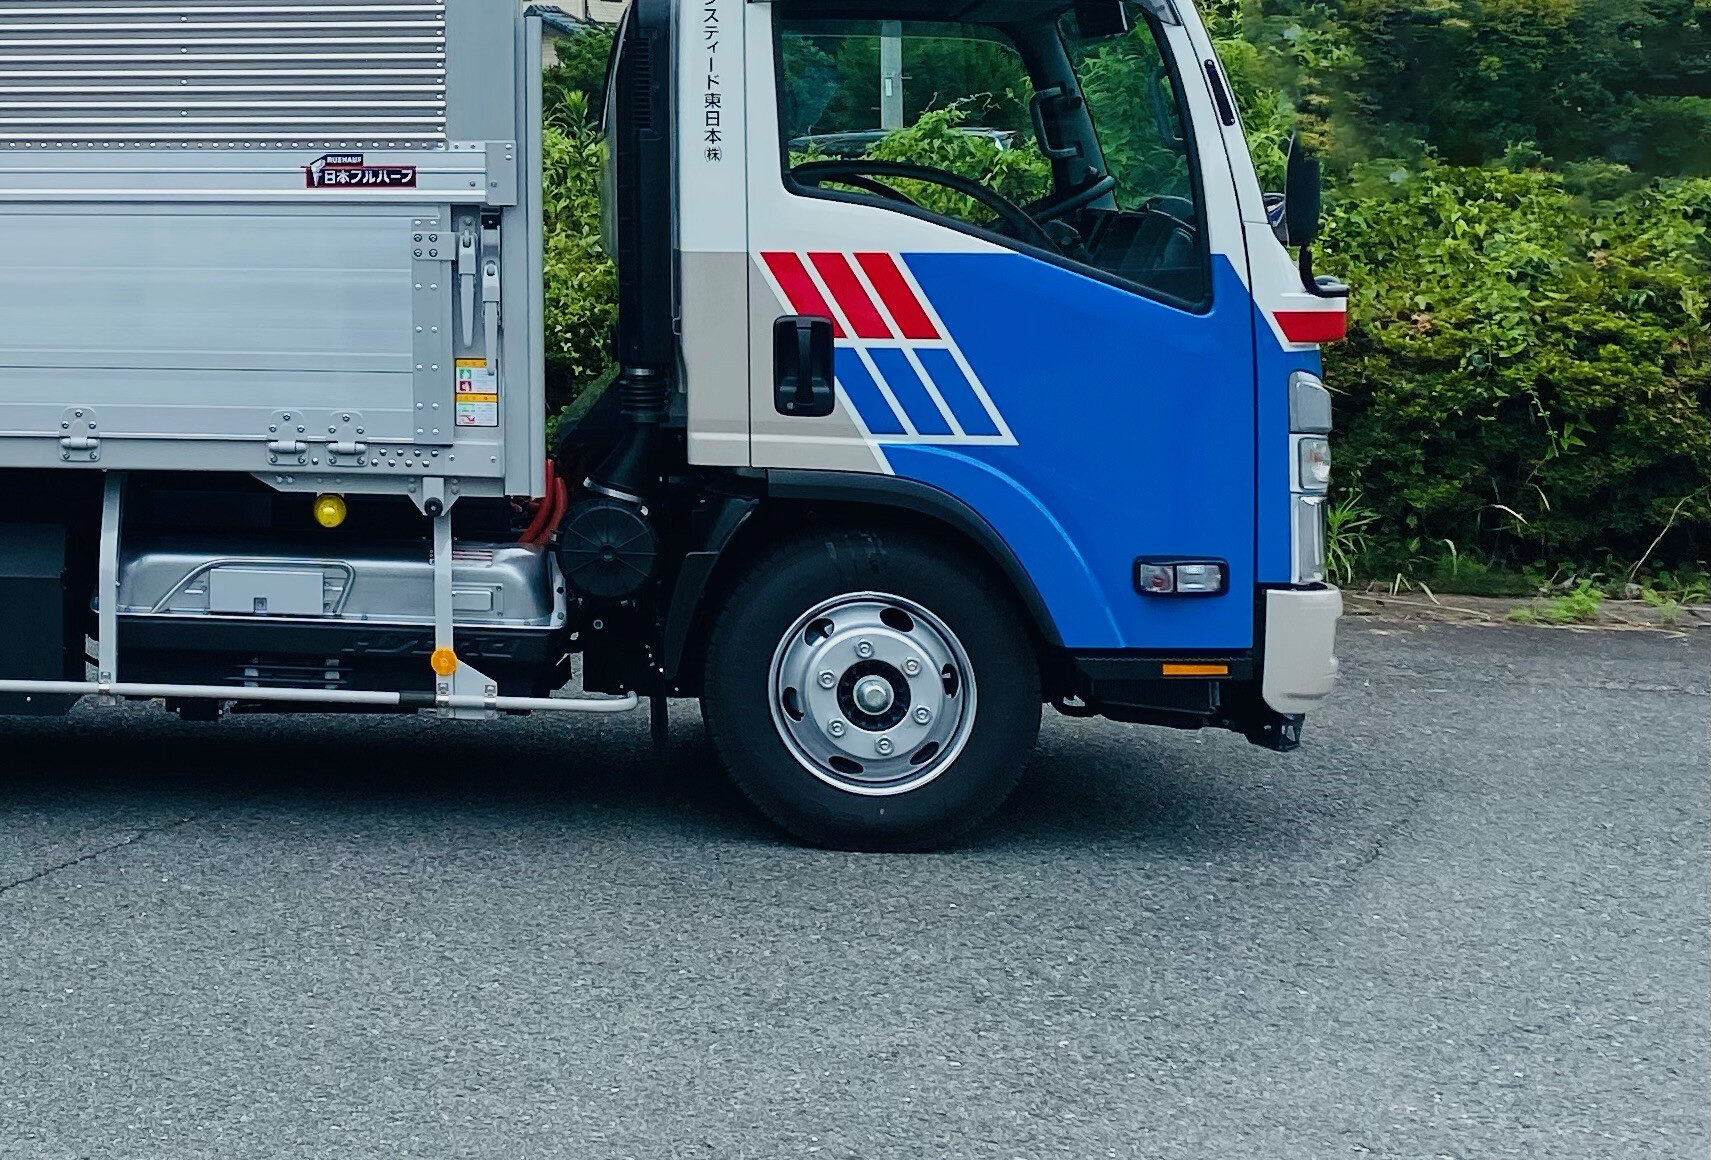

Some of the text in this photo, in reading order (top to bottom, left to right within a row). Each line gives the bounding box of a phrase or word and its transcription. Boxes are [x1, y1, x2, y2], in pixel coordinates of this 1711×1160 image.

[324, 170, 413, 184] 日本フルハーフ
